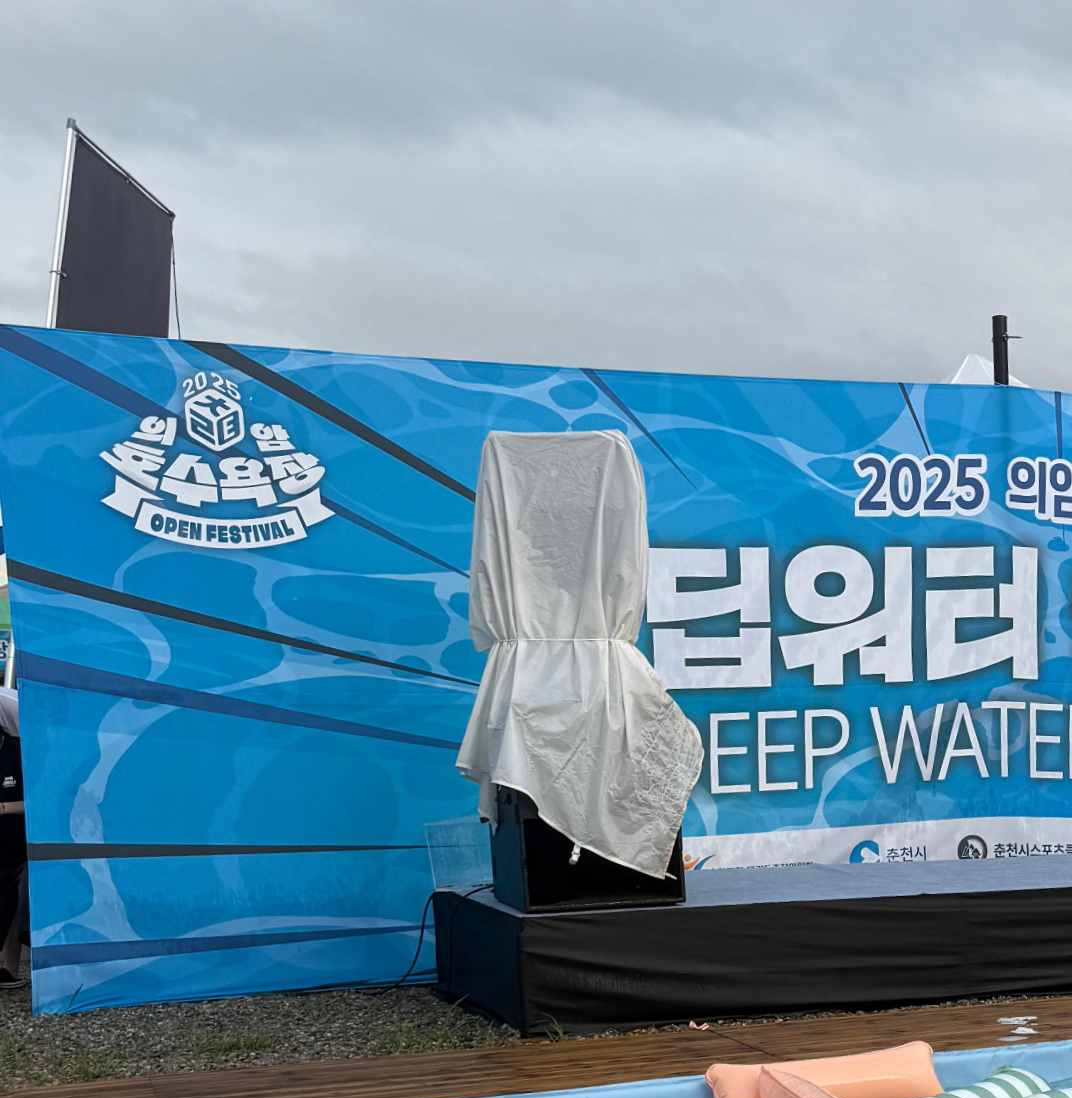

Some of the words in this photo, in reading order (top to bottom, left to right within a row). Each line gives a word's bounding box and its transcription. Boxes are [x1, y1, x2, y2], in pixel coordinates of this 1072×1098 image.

[182, 371, 242, 401] 2025
[855, 456, 986, 514] 2025
[150, 513, 202, 541] OPEN
[206, 517, 295, 544] FESTIVAL
[647, 545, 1039, 690] 딥워터
[709, 707, 851, 795] EEP
[886, 845, 928, 863] 춘천시
